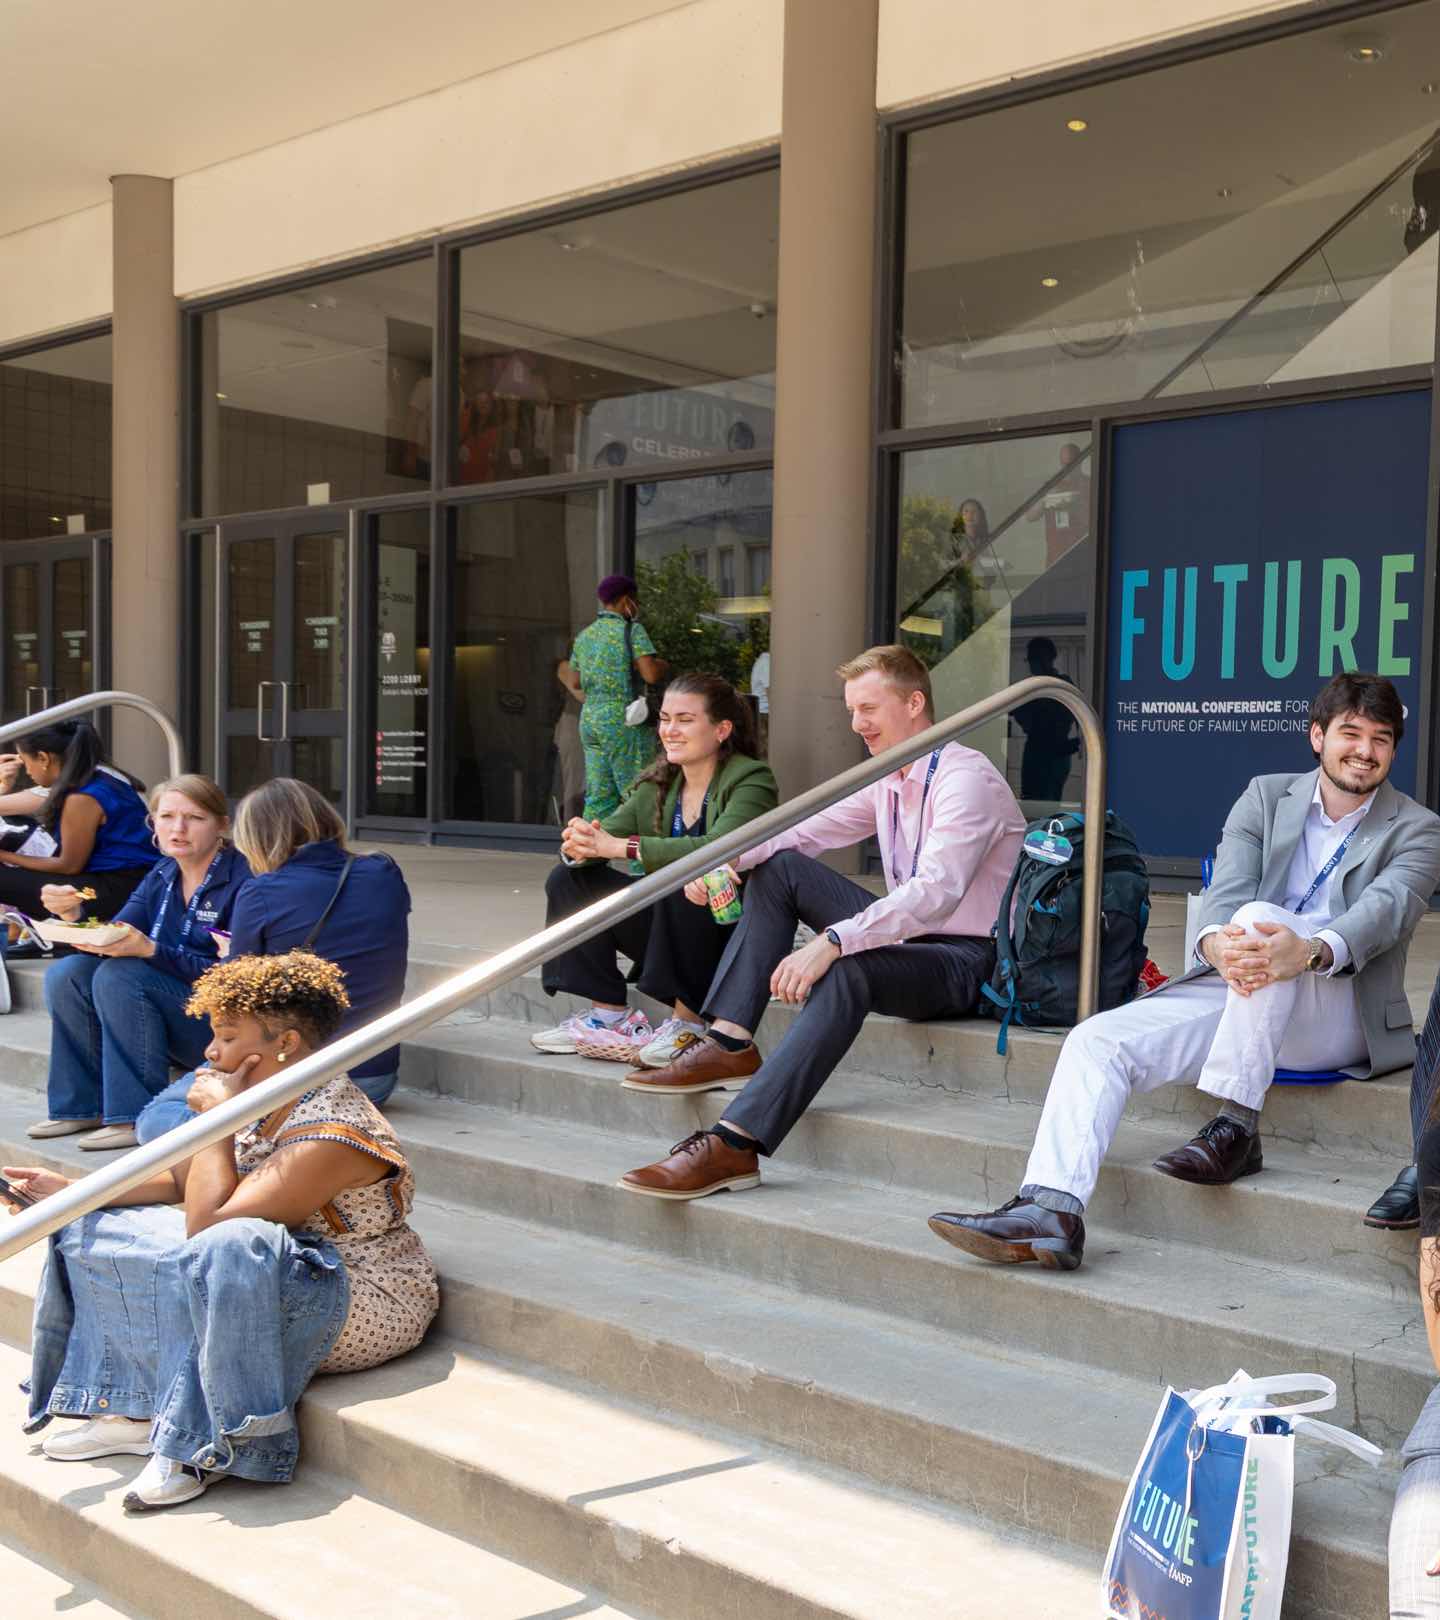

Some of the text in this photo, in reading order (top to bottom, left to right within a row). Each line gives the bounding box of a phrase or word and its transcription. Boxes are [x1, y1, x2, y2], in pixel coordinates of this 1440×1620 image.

[1119, 553, 1416, 681] FUTURE
[1117, 720, 1309, 732] THE FUTURE OF FAMILY MEDICINE
[1118, 700, 1309, 714] THE NATIONAL CONFERENCE FOR
[1133, 1480, 1199, 1567] FUTURE
